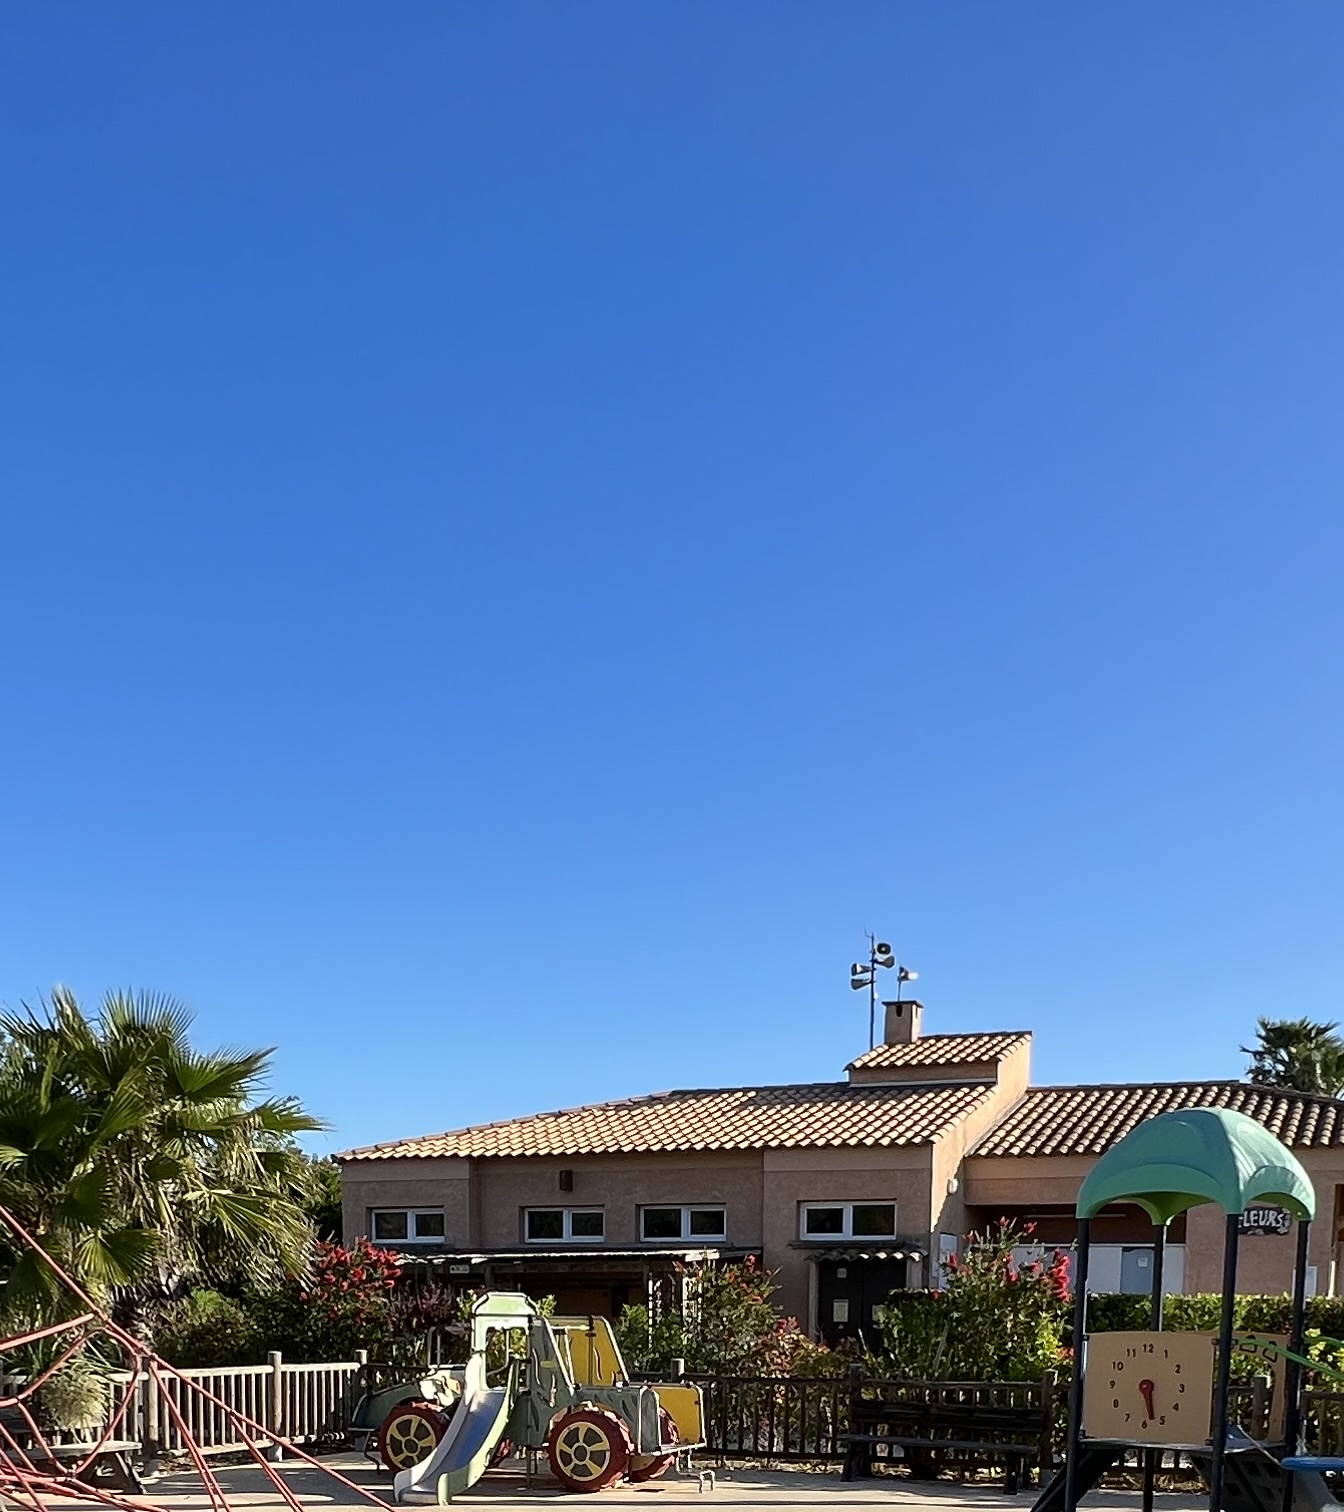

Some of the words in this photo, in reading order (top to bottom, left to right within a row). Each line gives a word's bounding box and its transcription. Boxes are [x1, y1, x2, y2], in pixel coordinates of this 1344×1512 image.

[1238, 1209, 1285, 1227] LEURS
[1126, 1348, 1136, 1358] 11
[1142, 1343, 1154, 1354] 12
[1112, 1361, 1124, 1371] 10
[1175, 1364, 1181, 1374] 2
[1109, 1380, 1116, 1389] 9
[1178, 1384, 1185, 1393] 3
[1172, 1403, 1179, 1411] 4
[1124, 1413, 1130, 1422] 7
[1159, 1416, 1166, 1425] 5
[1141, 1420, 1148, 1429] 6
